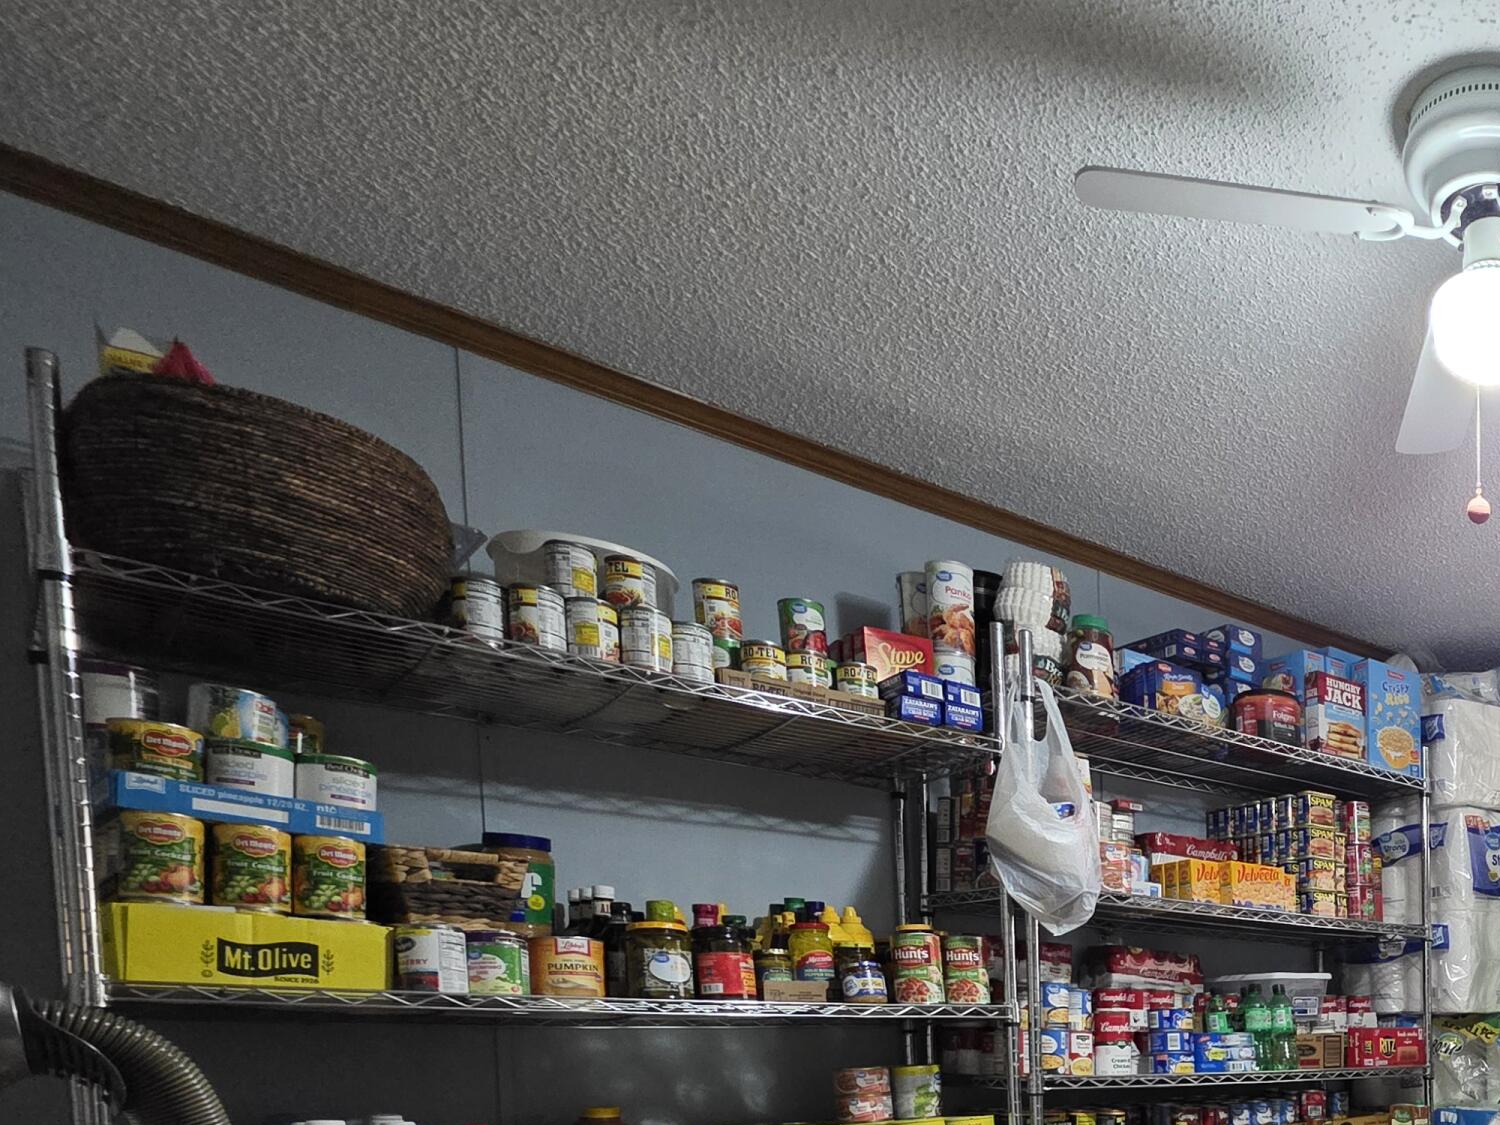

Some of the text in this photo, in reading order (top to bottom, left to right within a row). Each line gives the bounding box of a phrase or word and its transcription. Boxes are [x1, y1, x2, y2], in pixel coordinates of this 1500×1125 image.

[877, 642, 925, 668] Stove
[1326, 677, 1361, 694] HUNGRY
[1325, 687, 1362, 710] JACK
[179, 783, 216, 798] SLICED
[1311, 796, 1333, 808] SPAM
[1311, 828, 1334, 840] SPAM
[1186, 843, 1228, 861] Campbell's
[1313, 859, 1336, 870] SPAM
[1237, 864, 1280, 883] Velveeta
[1313, 891, 1336, 903] SPAM
[224, 946, 313, 972] Mt. Olive
[895, 949, 930, 961] Hunt's
[946, 950, 980, 964] Hunt's
[547, 961, 599, 973] PUMPKIN
[1380, 1037, 1396, 1054] RITZ
